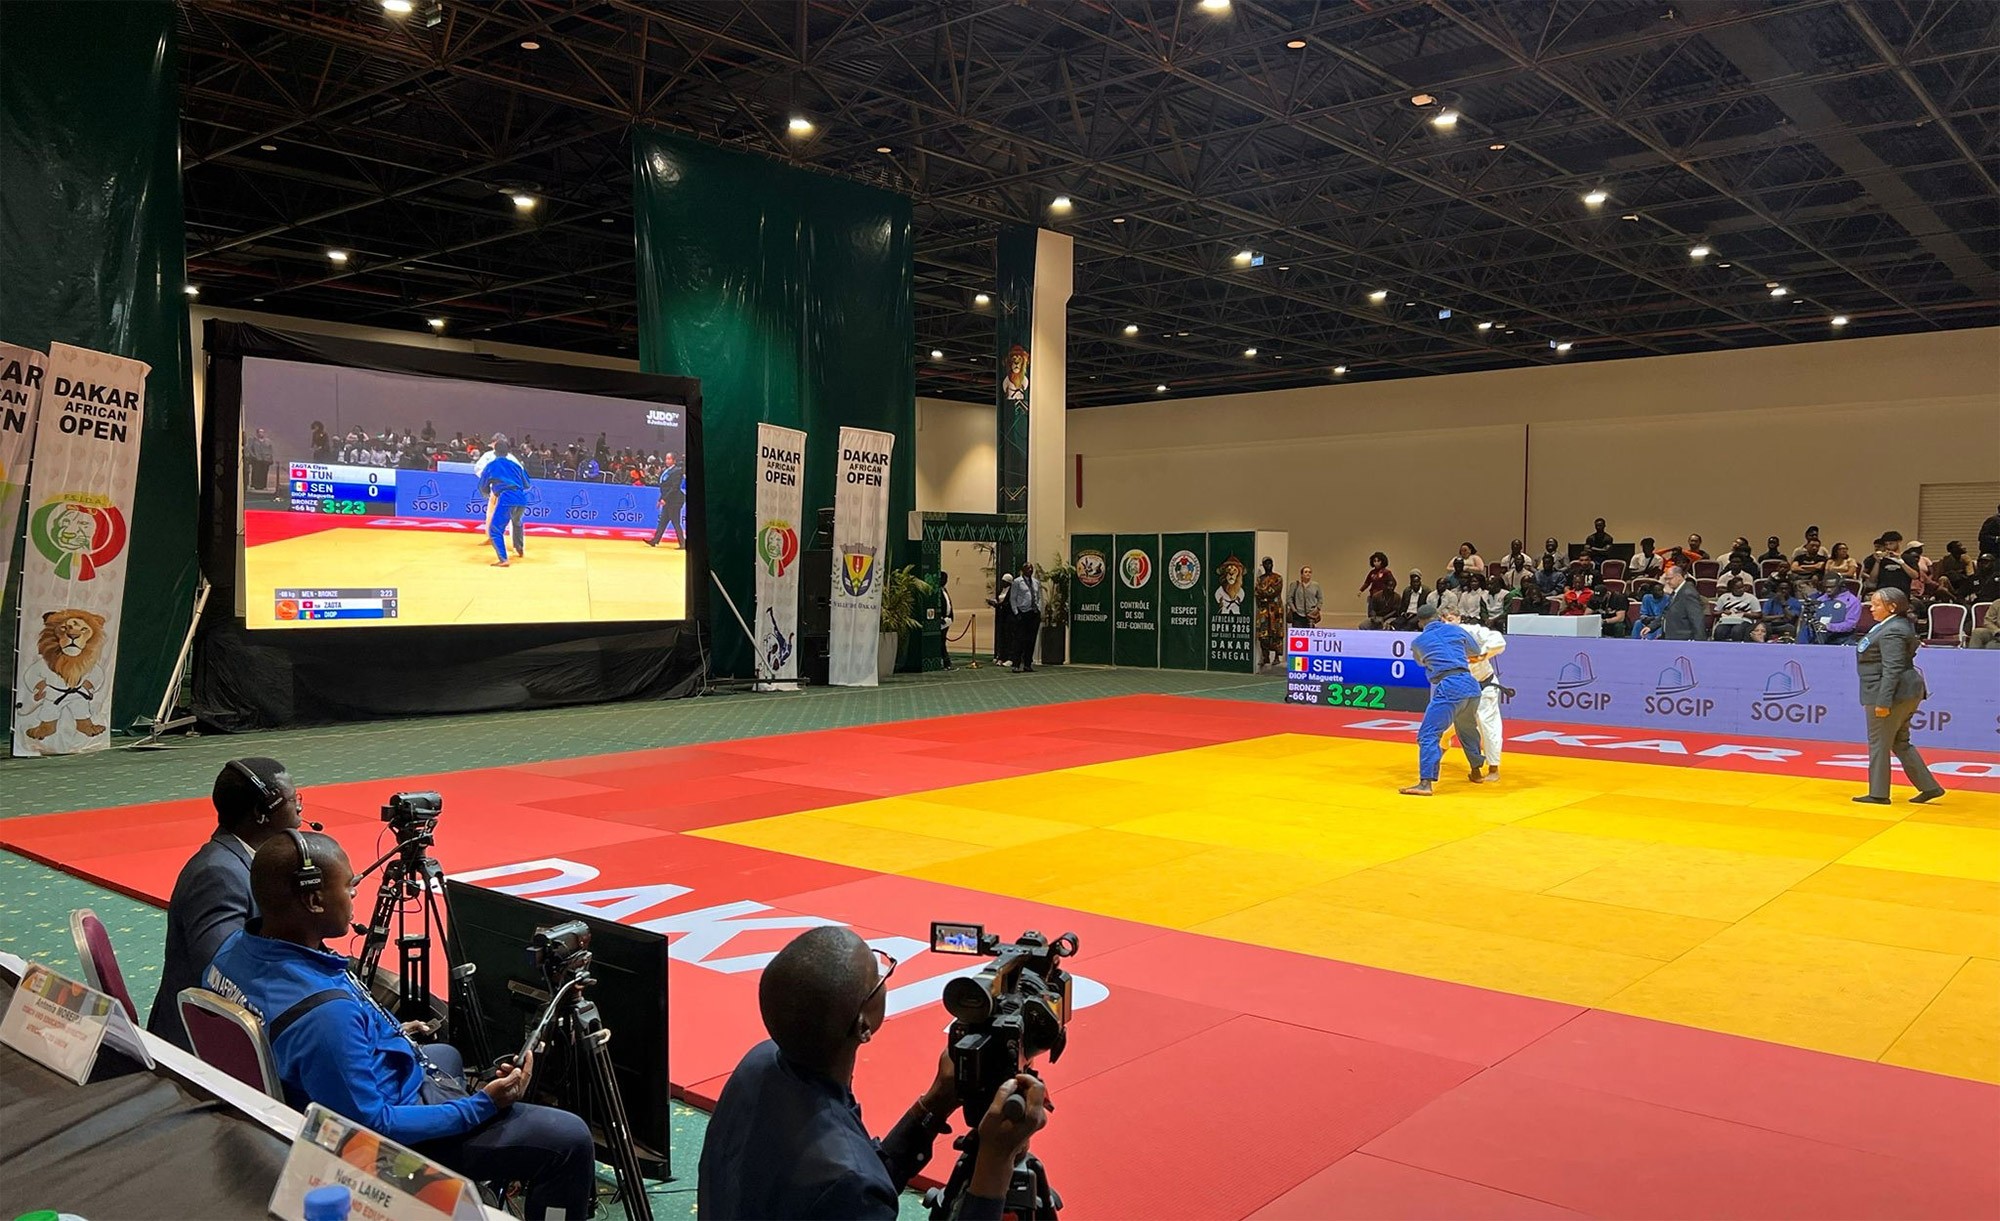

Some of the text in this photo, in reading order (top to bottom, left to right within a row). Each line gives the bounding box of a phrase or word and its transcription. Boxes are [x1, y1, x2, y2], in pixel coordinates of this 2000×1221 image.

[54, 377, 139, 411] DAKAR
[64, 401, 127, 422] AFRICAN
[59, 415, 127, 443] OPEN
[762, 446, 801, 464] DAKAR
[843, 449, 889, 466] DAKAR
[767, 461, 796, 473] AFRICAN
[849, 463, 882, 474] AFRICAN
[311, 470, 378, 484] TUN 0
[765, 470, 796, 486] OPEN
[847, 471, 882, 487] OPEN
[310, 483, 379, 497] SEN 0
[322, 499, 366, 515] 3:23
[412, 500, 448, 512] SOGIP
[465, 503, 488, 514] SOG
[565, 509, 598, 520] SOGIP
[612, 511, 643, 523] SOGIP
[1081, 602, 1100, 612] AMITIÉ
[1120, 600, 1149, 610] CONTRÔLE
[1171, 606, 1197, 615] RESPECT
[1074, 614, 1108, 622] FRIENDSHIP
[1171, 617, 1197, 626] RESPECT
[1211, 615, 1250, 624] AFRICAN JUDO
[1116, 622, 1155, 630] SELF-CONTROL
[1211, 623, 1250, 633] OPEN 2026
[1317, 630, 1336, 638] Elyas
[1211, 640, 1250, 650] DAKAR
[1313, 640, 1405, 657] TUN 0
[1211, 650, 1250, 661] SENEGAL
[1313, 660, 1405, 679] SEN 0
[1308, 673, 1343, 682] Maguette
[1289, 683, 1321, 693] BRONZE
[1288, 683, 1386, 708] -66 kg 3:22
[1547, 690, 1611, 710] SOGIP
[1644, 695, 1714, 717] SOGIP
[1751, 701, 1828, 724] SOGIP
[1908, 709, 1952, 732] GIP
[1341, 718, 1803, 763] DKAR
[358, 1181, 392, 1208] LAMPE
